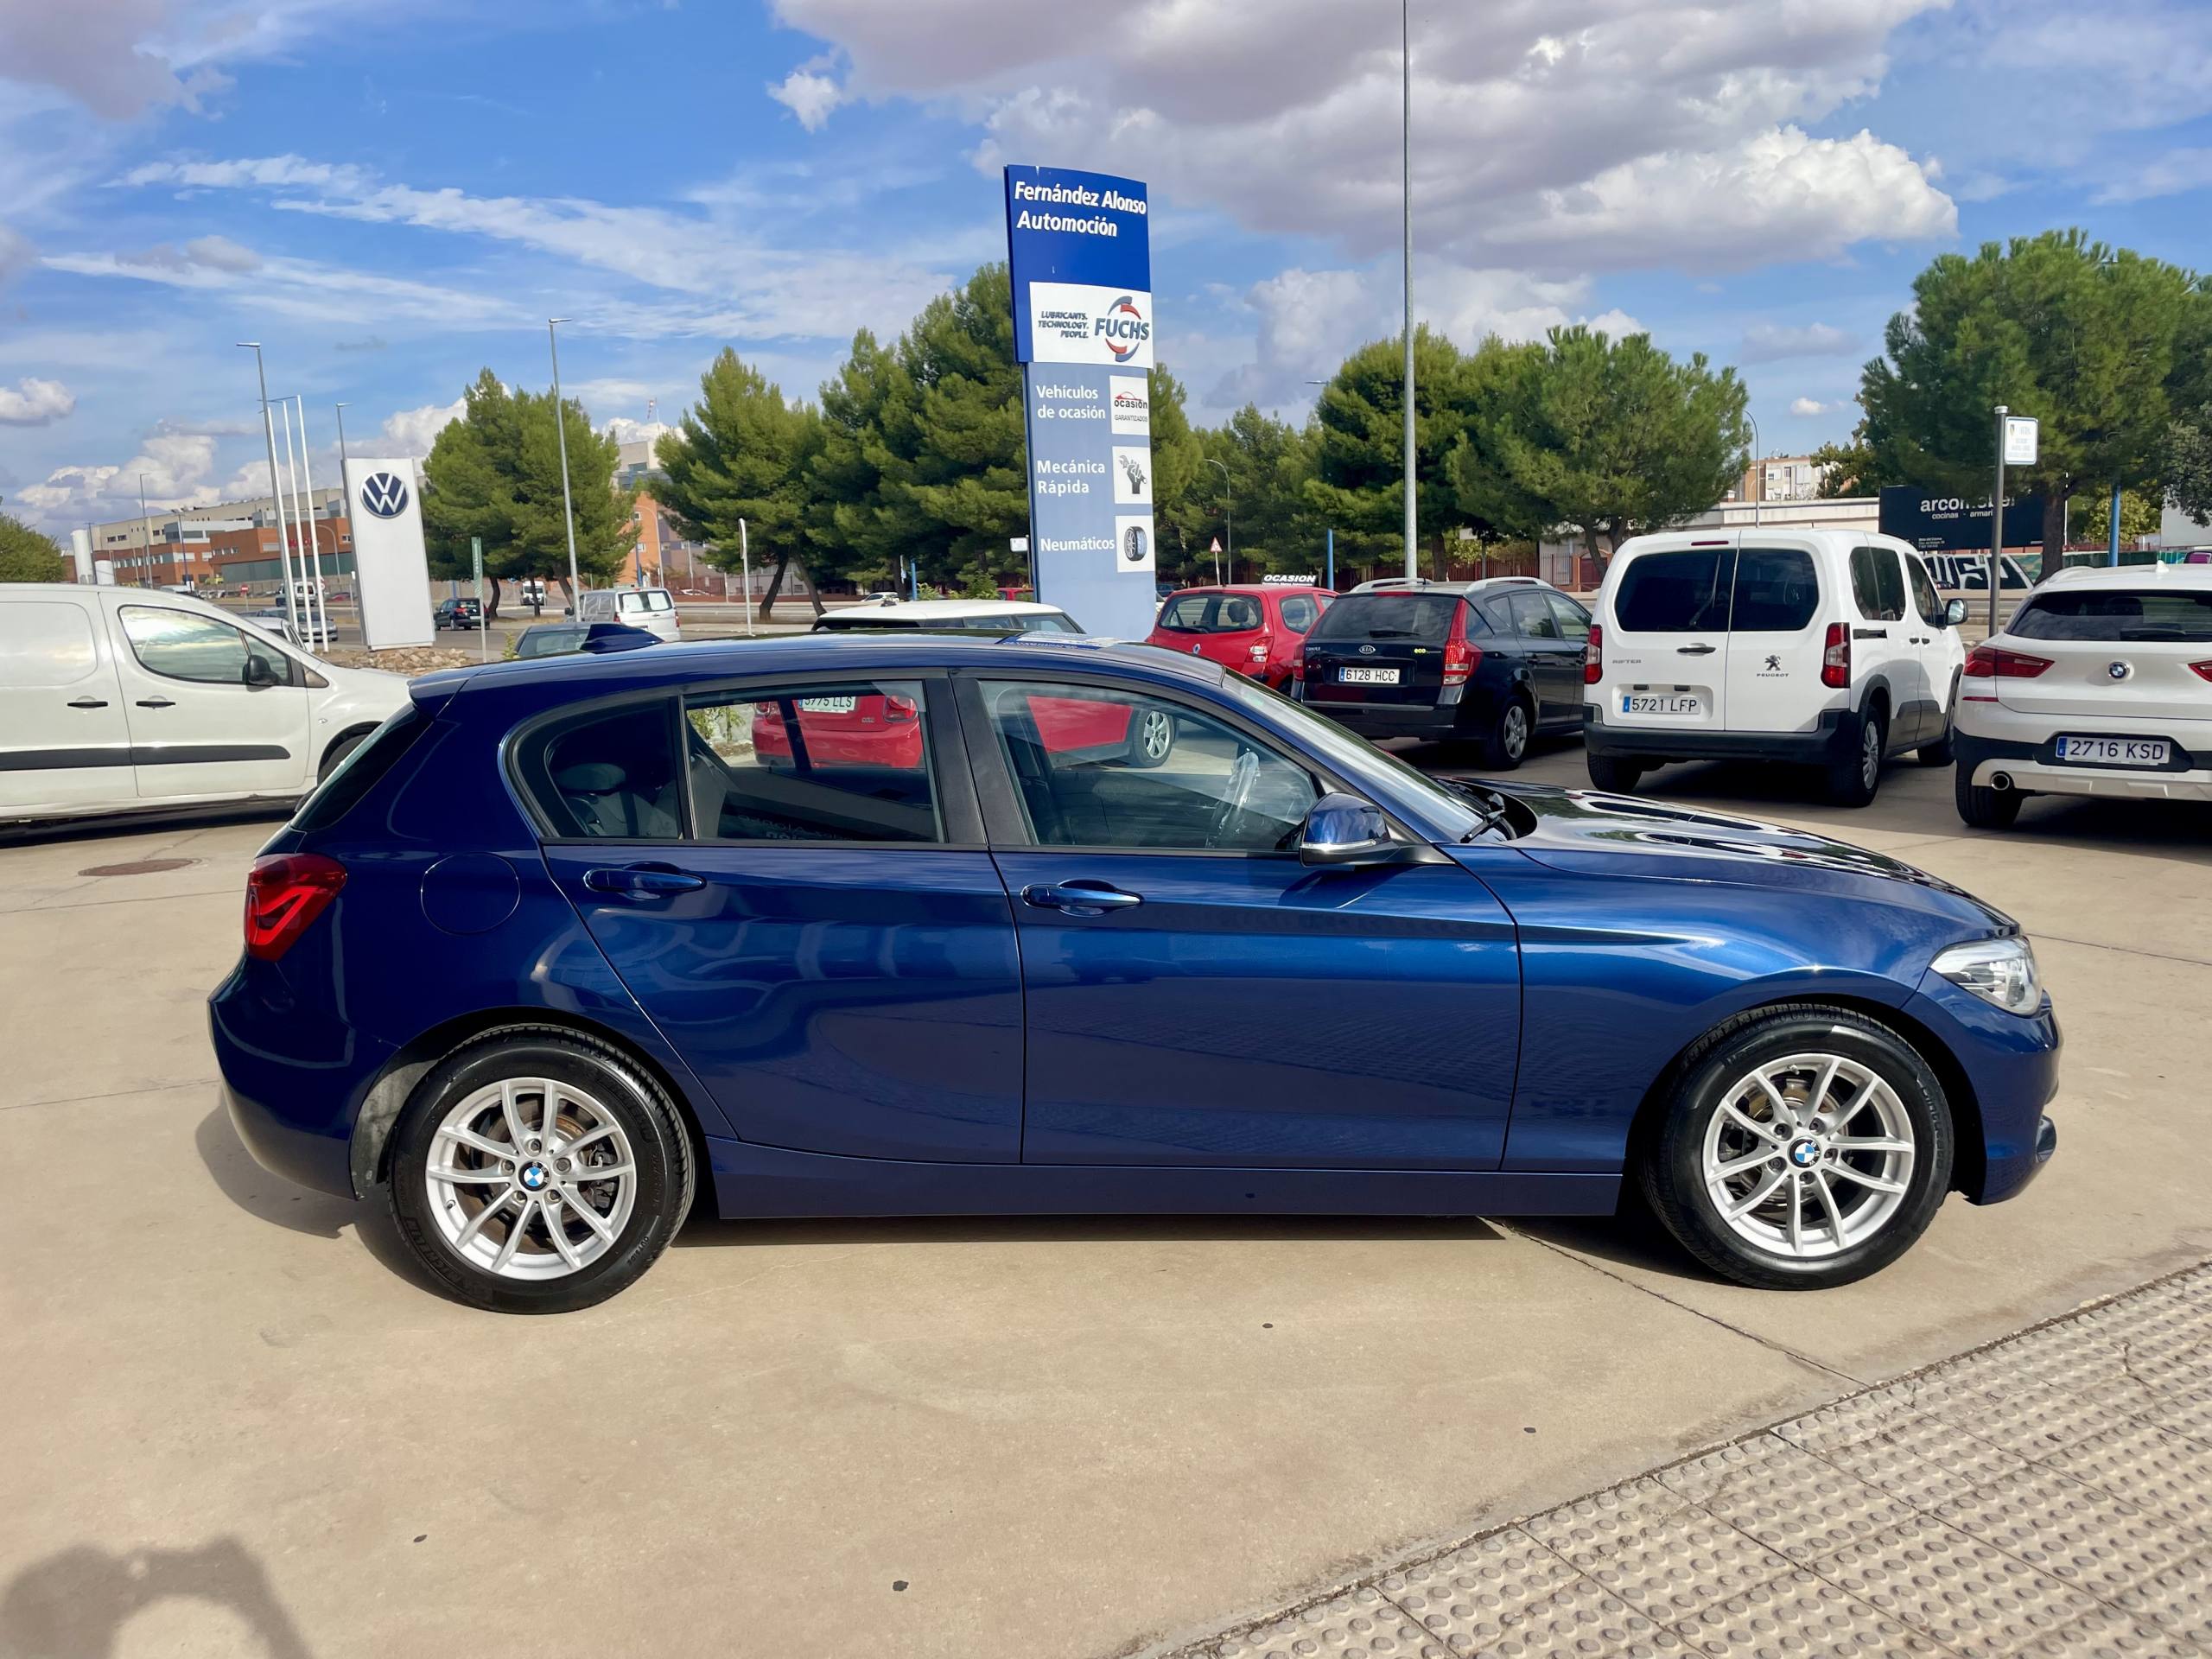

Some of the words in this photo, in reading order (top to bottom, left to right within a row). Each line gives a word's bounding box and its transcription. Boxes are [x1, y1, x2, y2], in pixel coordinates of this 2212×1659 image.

[1014, 181, 1098, 207] Fernández
[1102, 190, 1147, 215] Alonso
[1016, 210, 1117, 238] Automoción
[1094, 318, 1149, 340] FUCHS
[1036, 385, 1098, 399] Vehículos
[1037, 405, 1055, 418] de
[1058, 405, 1106, 419] ocasión
[1037, 460, 1105, 474] Mecánica
[1038, 480, 1090, 497] Rápida
[1039, 537, 1115, 551] Neumáticos
[1346, 670, 1370, 681] 6128
[1375, 670, 1395, 681] HCC
[833, 696, 852, 708] LLS
[1631, 699, 1664, 712] 5721
[1670, 699, 1697, 713] LFP
[2070, 741, 2119, 757] 2716
[2126, 743, 2164, 760] KSD
